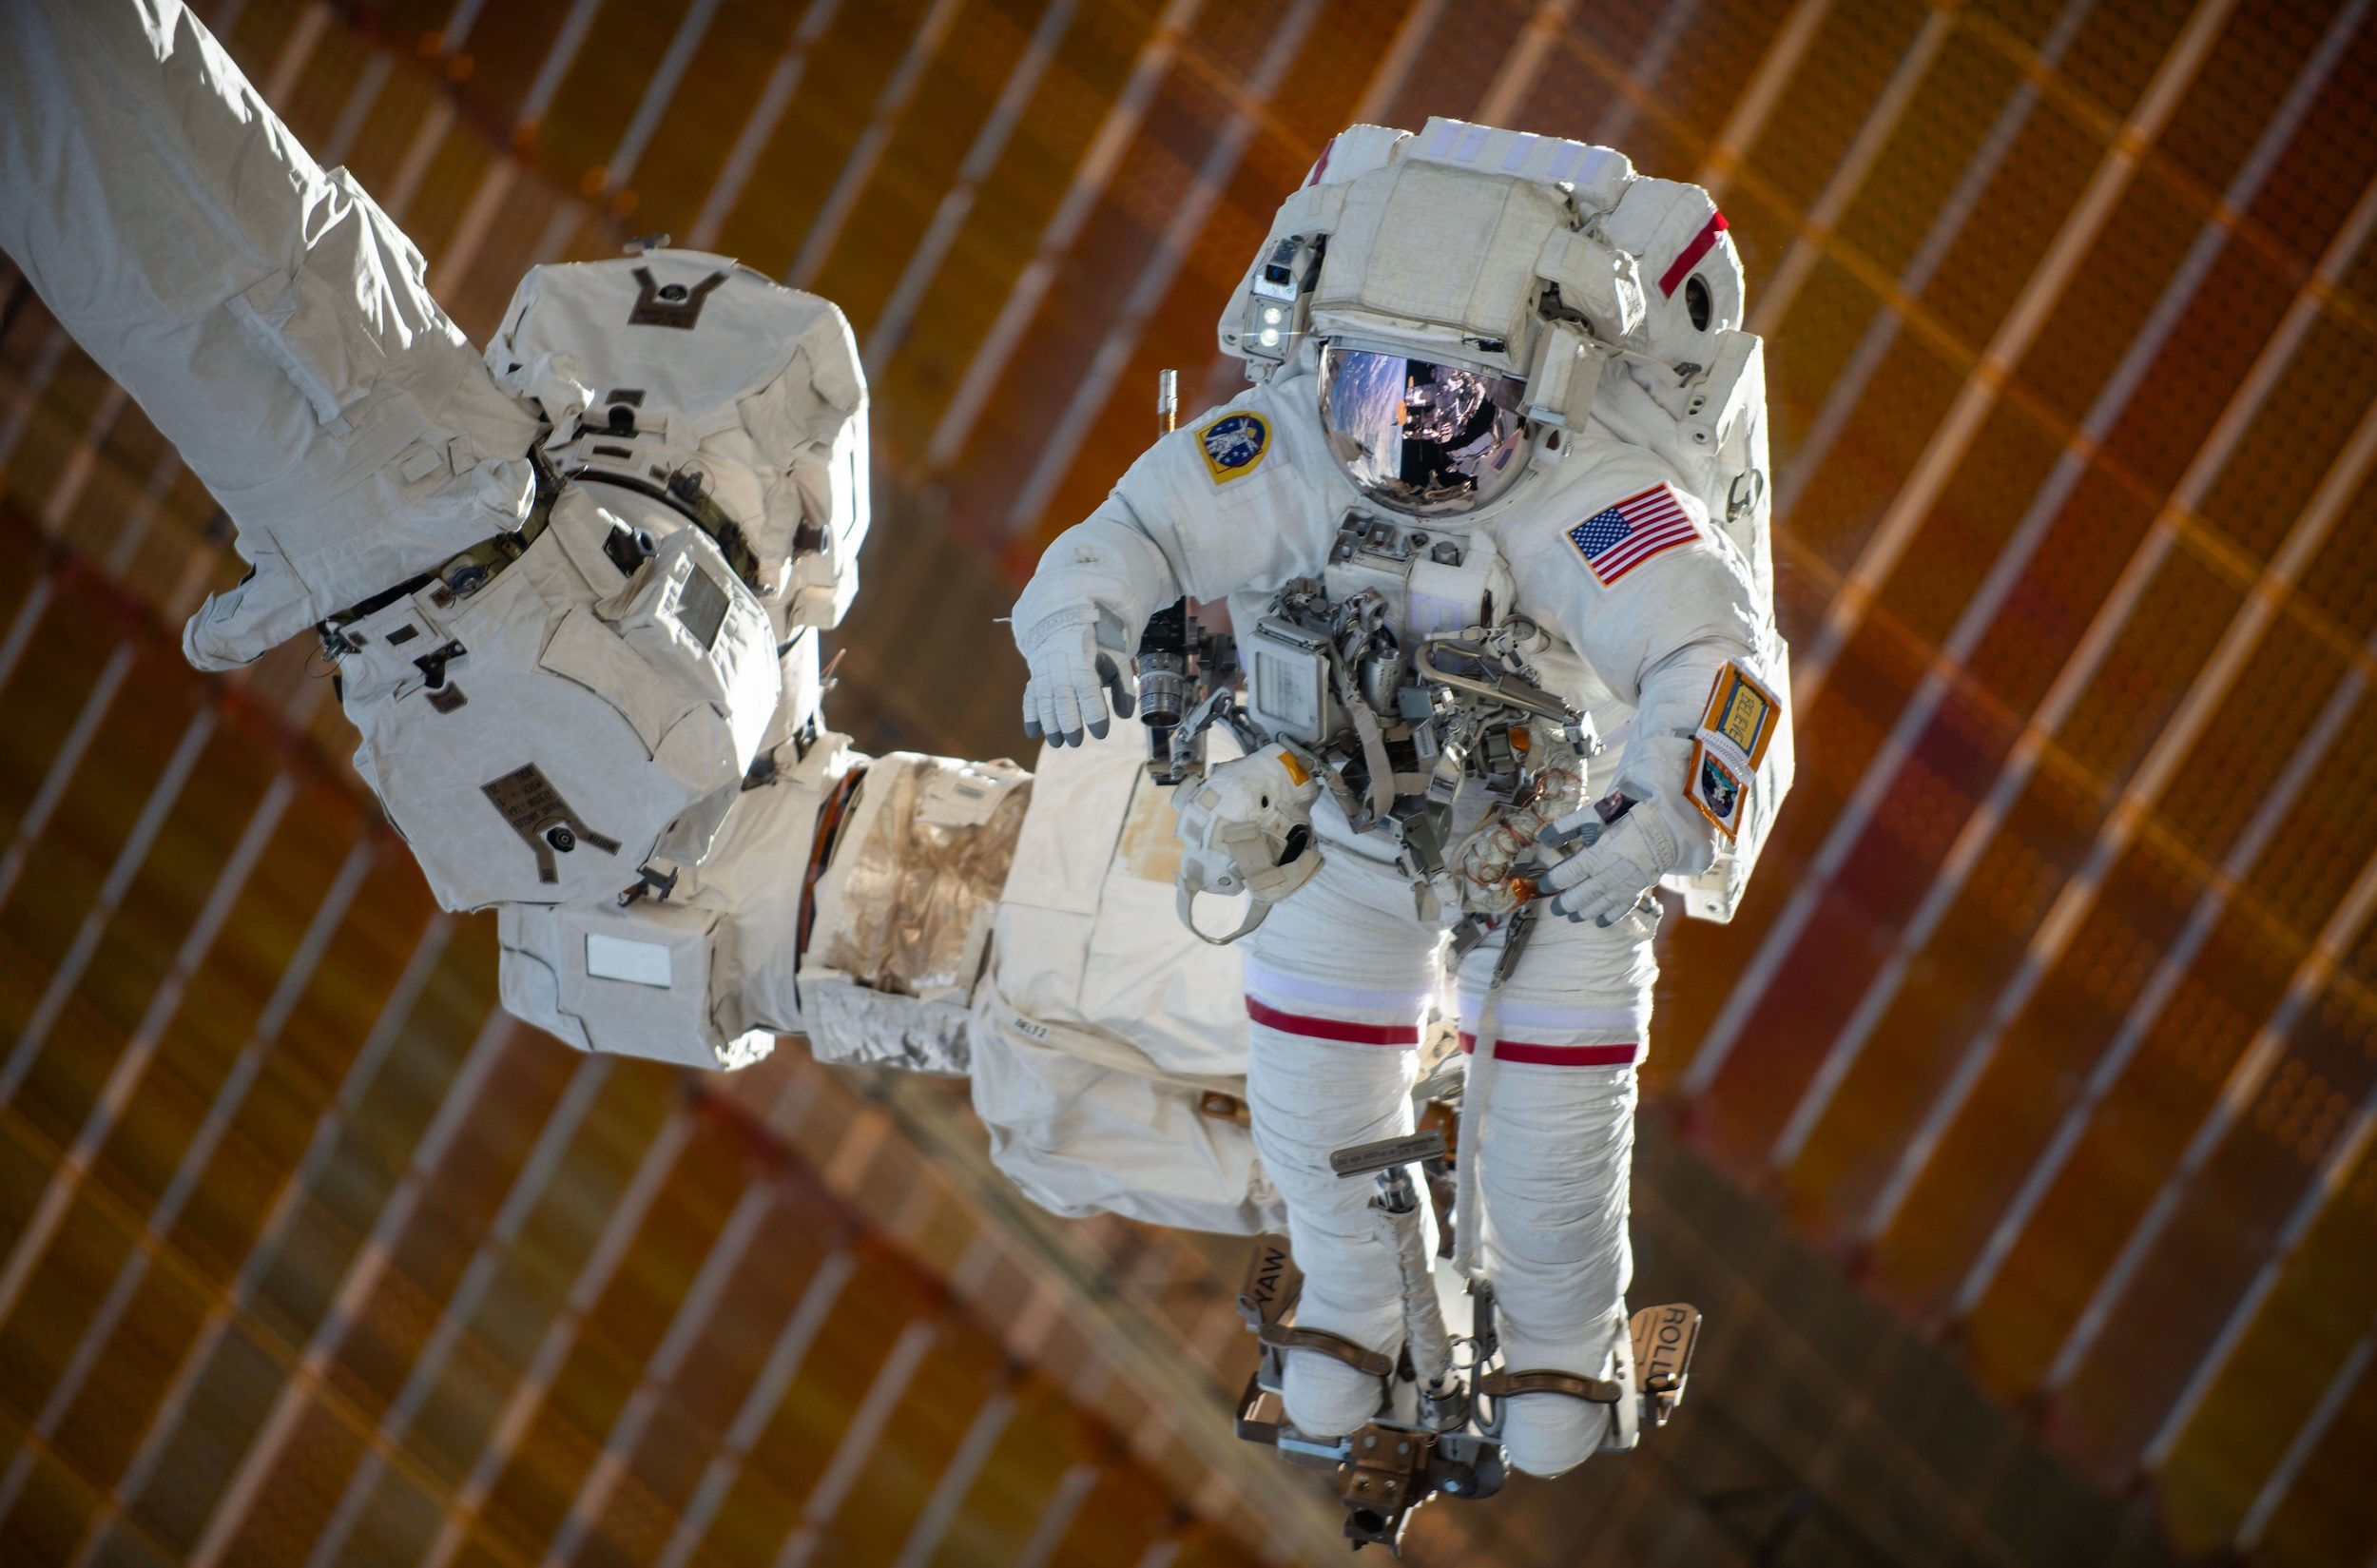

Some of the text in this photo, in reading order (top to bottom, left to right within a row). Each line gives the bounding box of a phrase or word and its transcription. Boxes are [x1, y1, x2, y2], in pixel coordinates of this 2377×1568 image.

[1730, 692, 1755, 744] BELIEVE
[1254, 1247, 1286, 1303] YAW
[1649, 1307, 1688, 1377] ROLL
